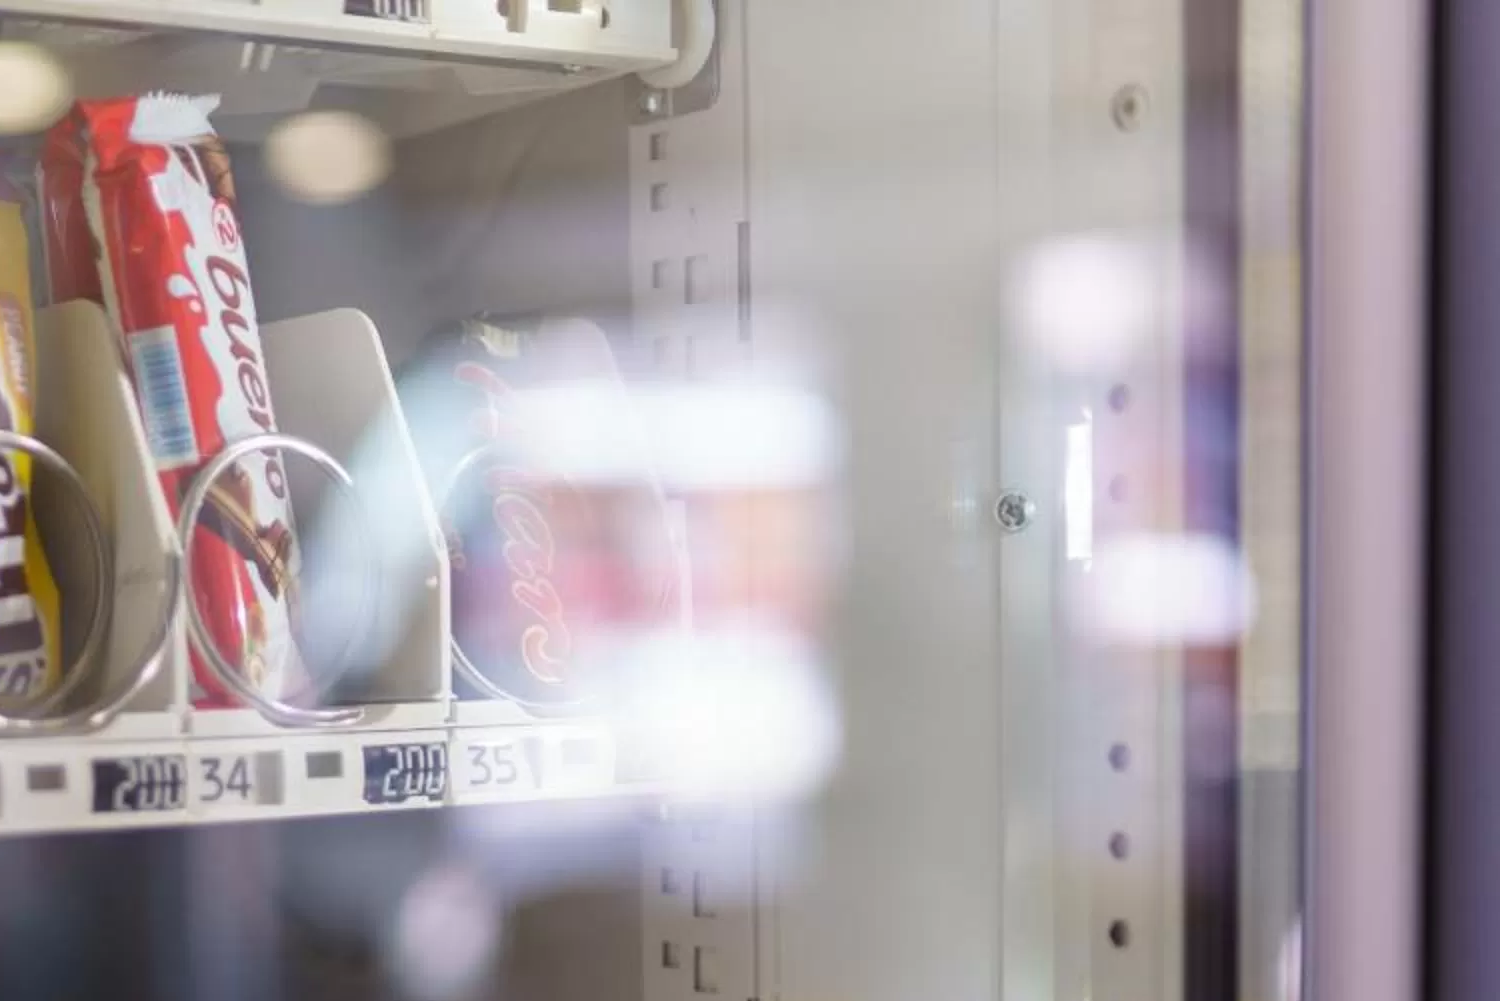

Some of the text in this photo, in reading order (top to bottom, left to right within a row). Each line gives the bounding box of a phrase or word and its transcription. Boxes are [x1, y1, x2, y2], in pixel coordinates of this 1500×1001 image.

[200, 755, 252, 803] 34
[383, 744, 446, 797] 200
[467, 744, 518, 787] 35
